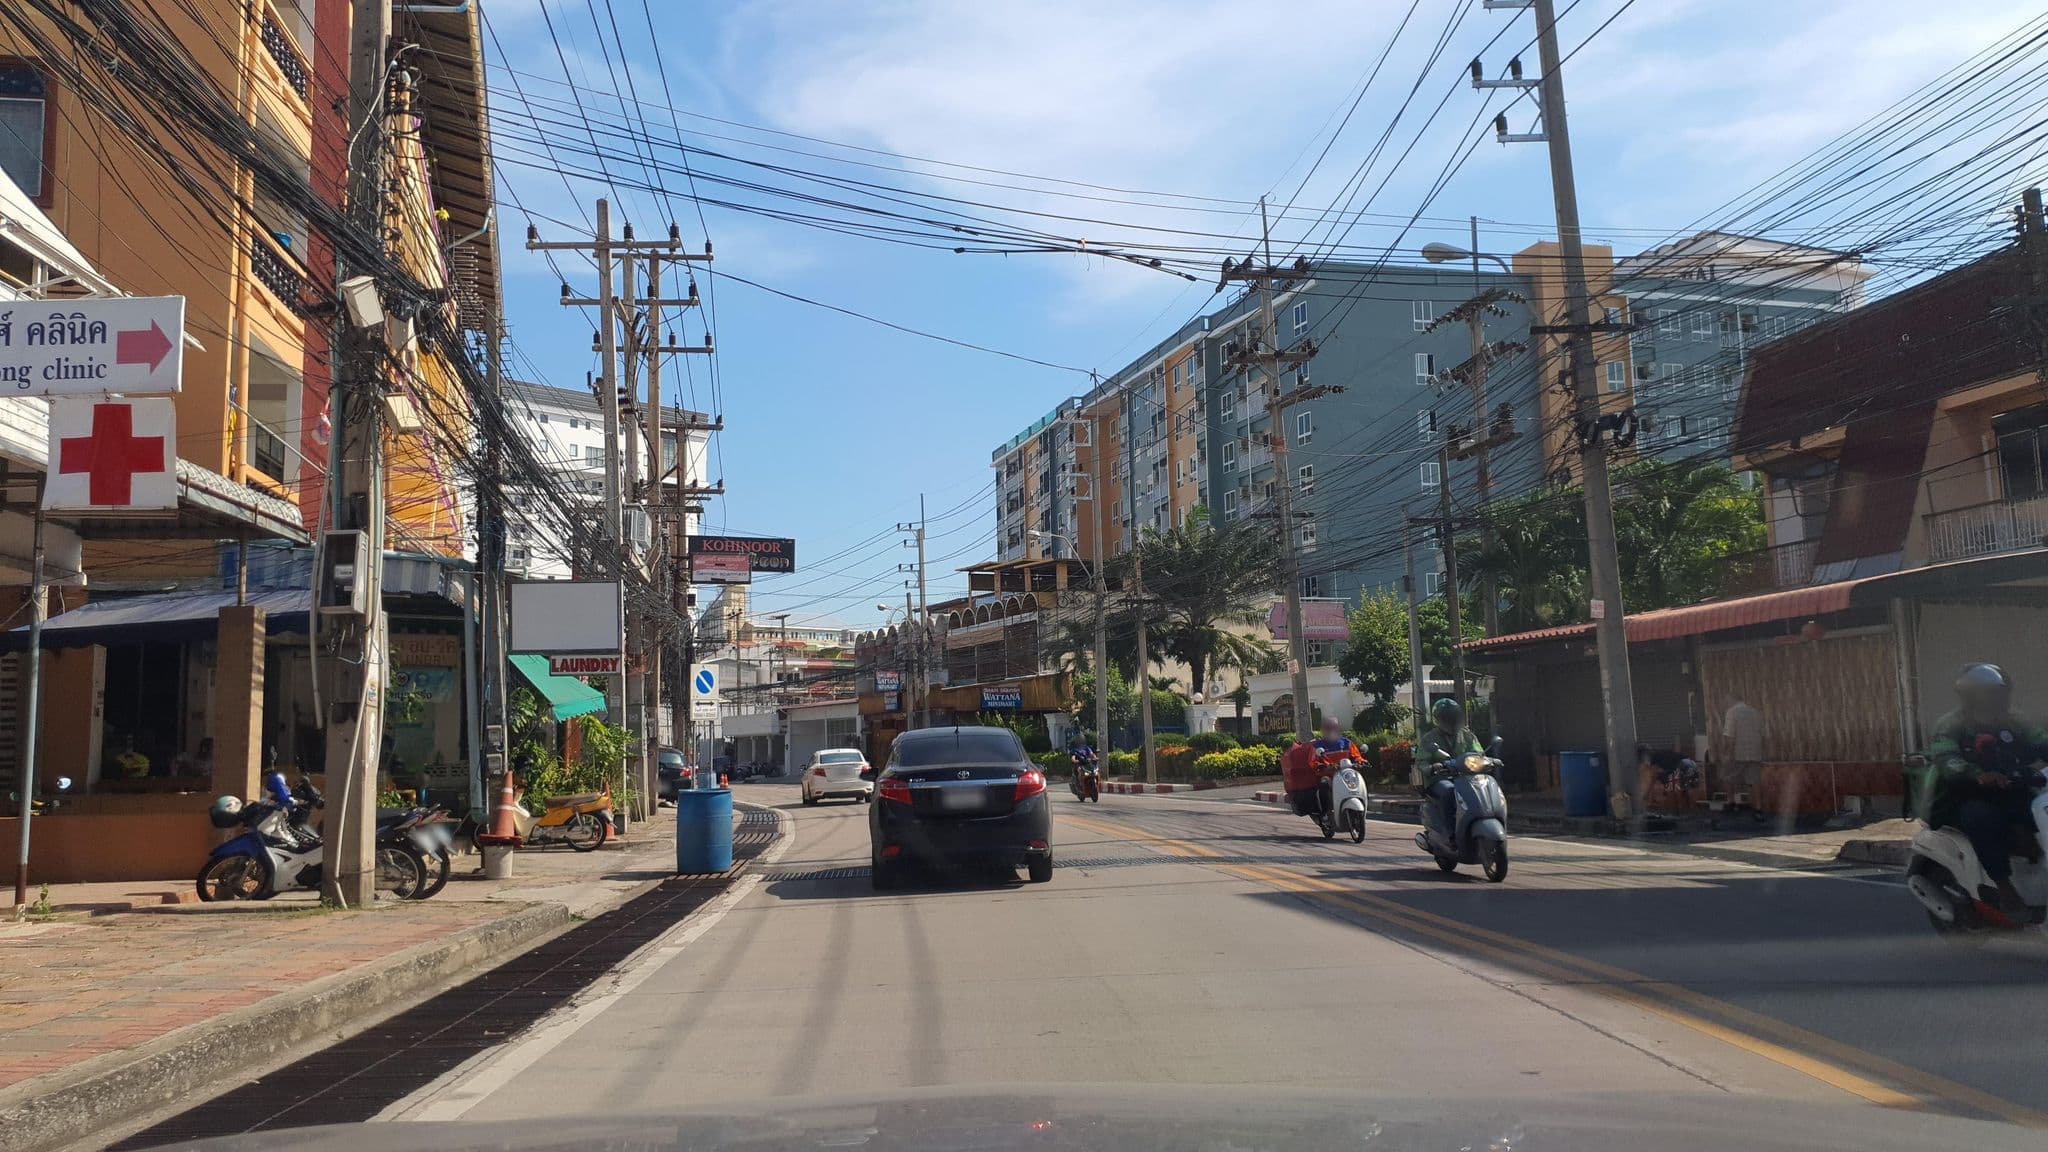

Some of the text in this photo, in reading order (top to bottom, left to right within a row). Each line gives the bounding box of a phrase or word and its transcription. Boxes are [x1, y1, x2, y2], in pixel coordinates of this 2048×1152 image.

[27, 312, 107, 346] คลินิค
[0, 356, 107, 390] ng clinic
[703, 540, 781, 553] KOHINOOR
[551, 658, 620, 673] LAUNDRY
[983, 692, 1021, 701] WATTANA
